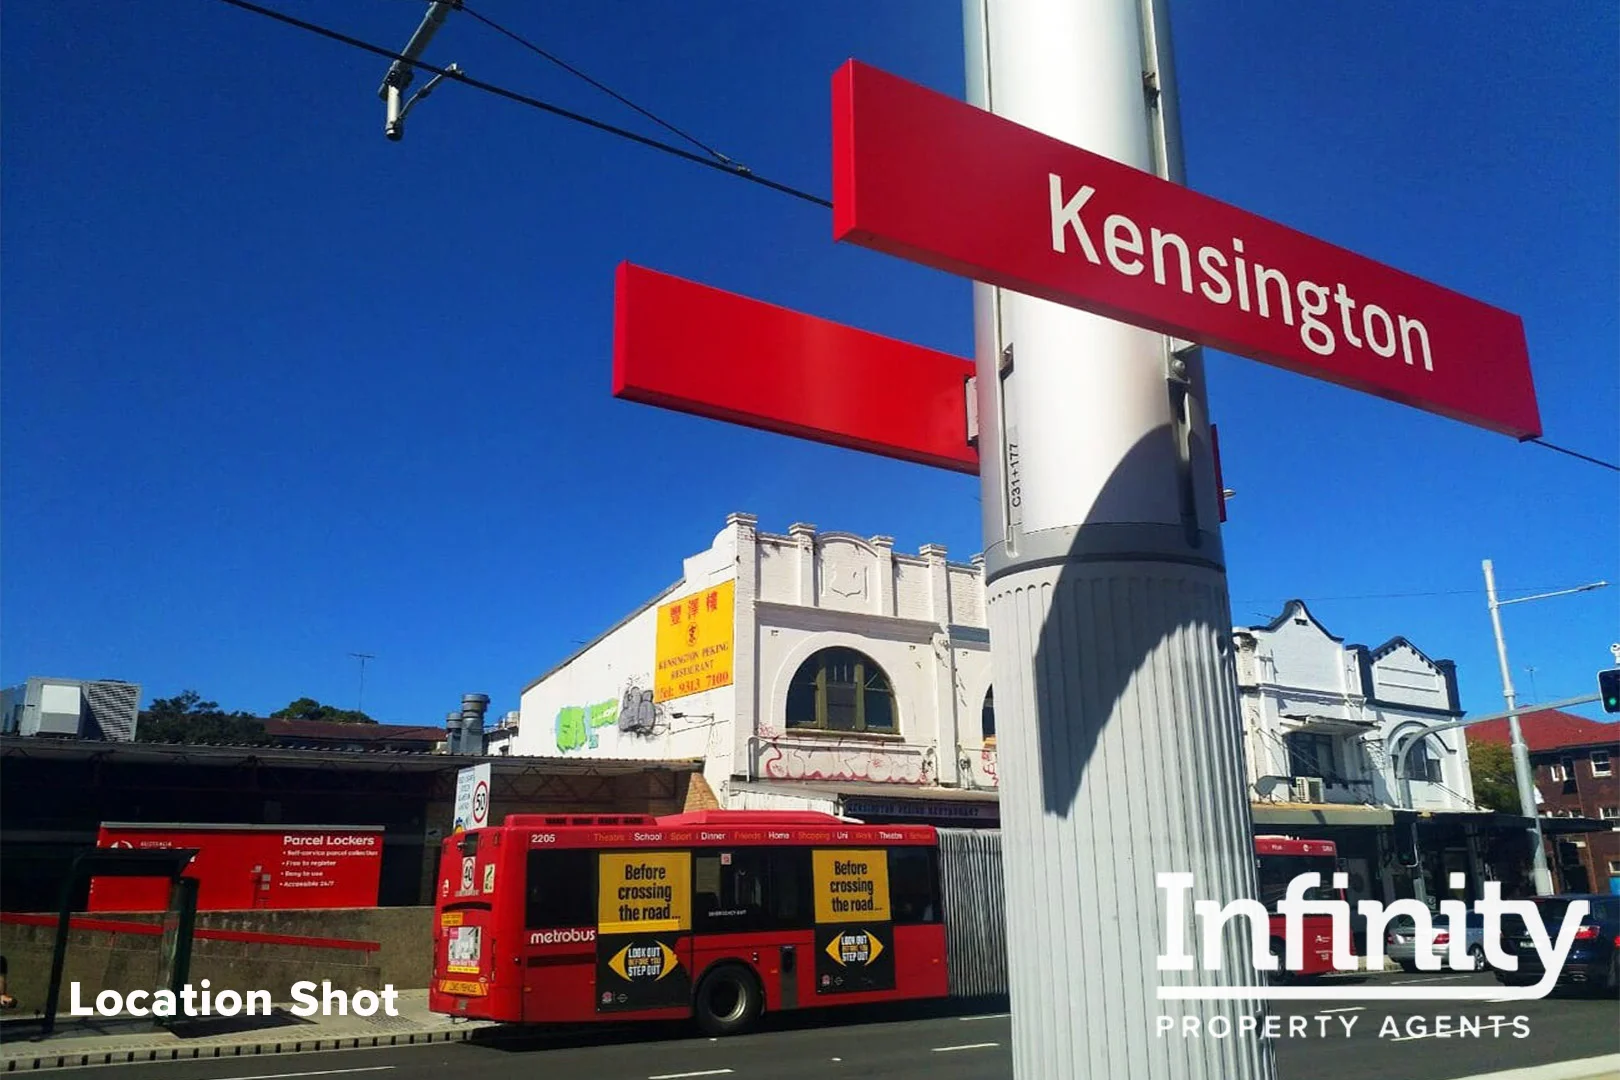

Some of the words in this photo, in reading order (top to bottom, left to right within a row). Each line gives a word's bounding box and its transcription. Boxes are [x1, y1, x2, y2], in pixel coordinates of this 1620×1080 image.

[1048, 172, 1434, 371] Kensington
[1009, 443, 1022, 508] C31+177
[658, 651, 699, 670] KENSINGTON
[702, 641, 728, 658] PEKING
[671, 659, 714, 680] RESTAURANT
[679, 678, 701, 693] 9313
[706, 671, 729, 686] 7100
[475, 793, 486, 811] 50
[284, 835, 324, 846] Parcel
[326, 835, 375, 846] Lockers
[531, 834, 556, 843] 2205
[634, 832, 662, 841] School
[670, 832, 692, 843] Sport
[701, 831, 726, 841] Dinner
[734, 831, 761, 841] Friends
[768, 831, 790, 840] Home
[798, 831, 830, 842] Shopping
[836, 831, 848, 840] Uni
[879, 831, 903, 840] Theatre
[625, 863, 666, 880] Before
[834, 860, 868, 875] Before
[618, 882, 672, 903] crossing
[830, 877, 873, 896] crossing
[619, 904, 640, 921] the
[832, 896, 849, 912] the
[530, 928, 596, 945] metrobus
[627, 947, 646, 958] LOOK
[646, 946, 661, 957] OUT
[628, 966, 646, 977] STEP
[646, 965, 661, 976] OUT
